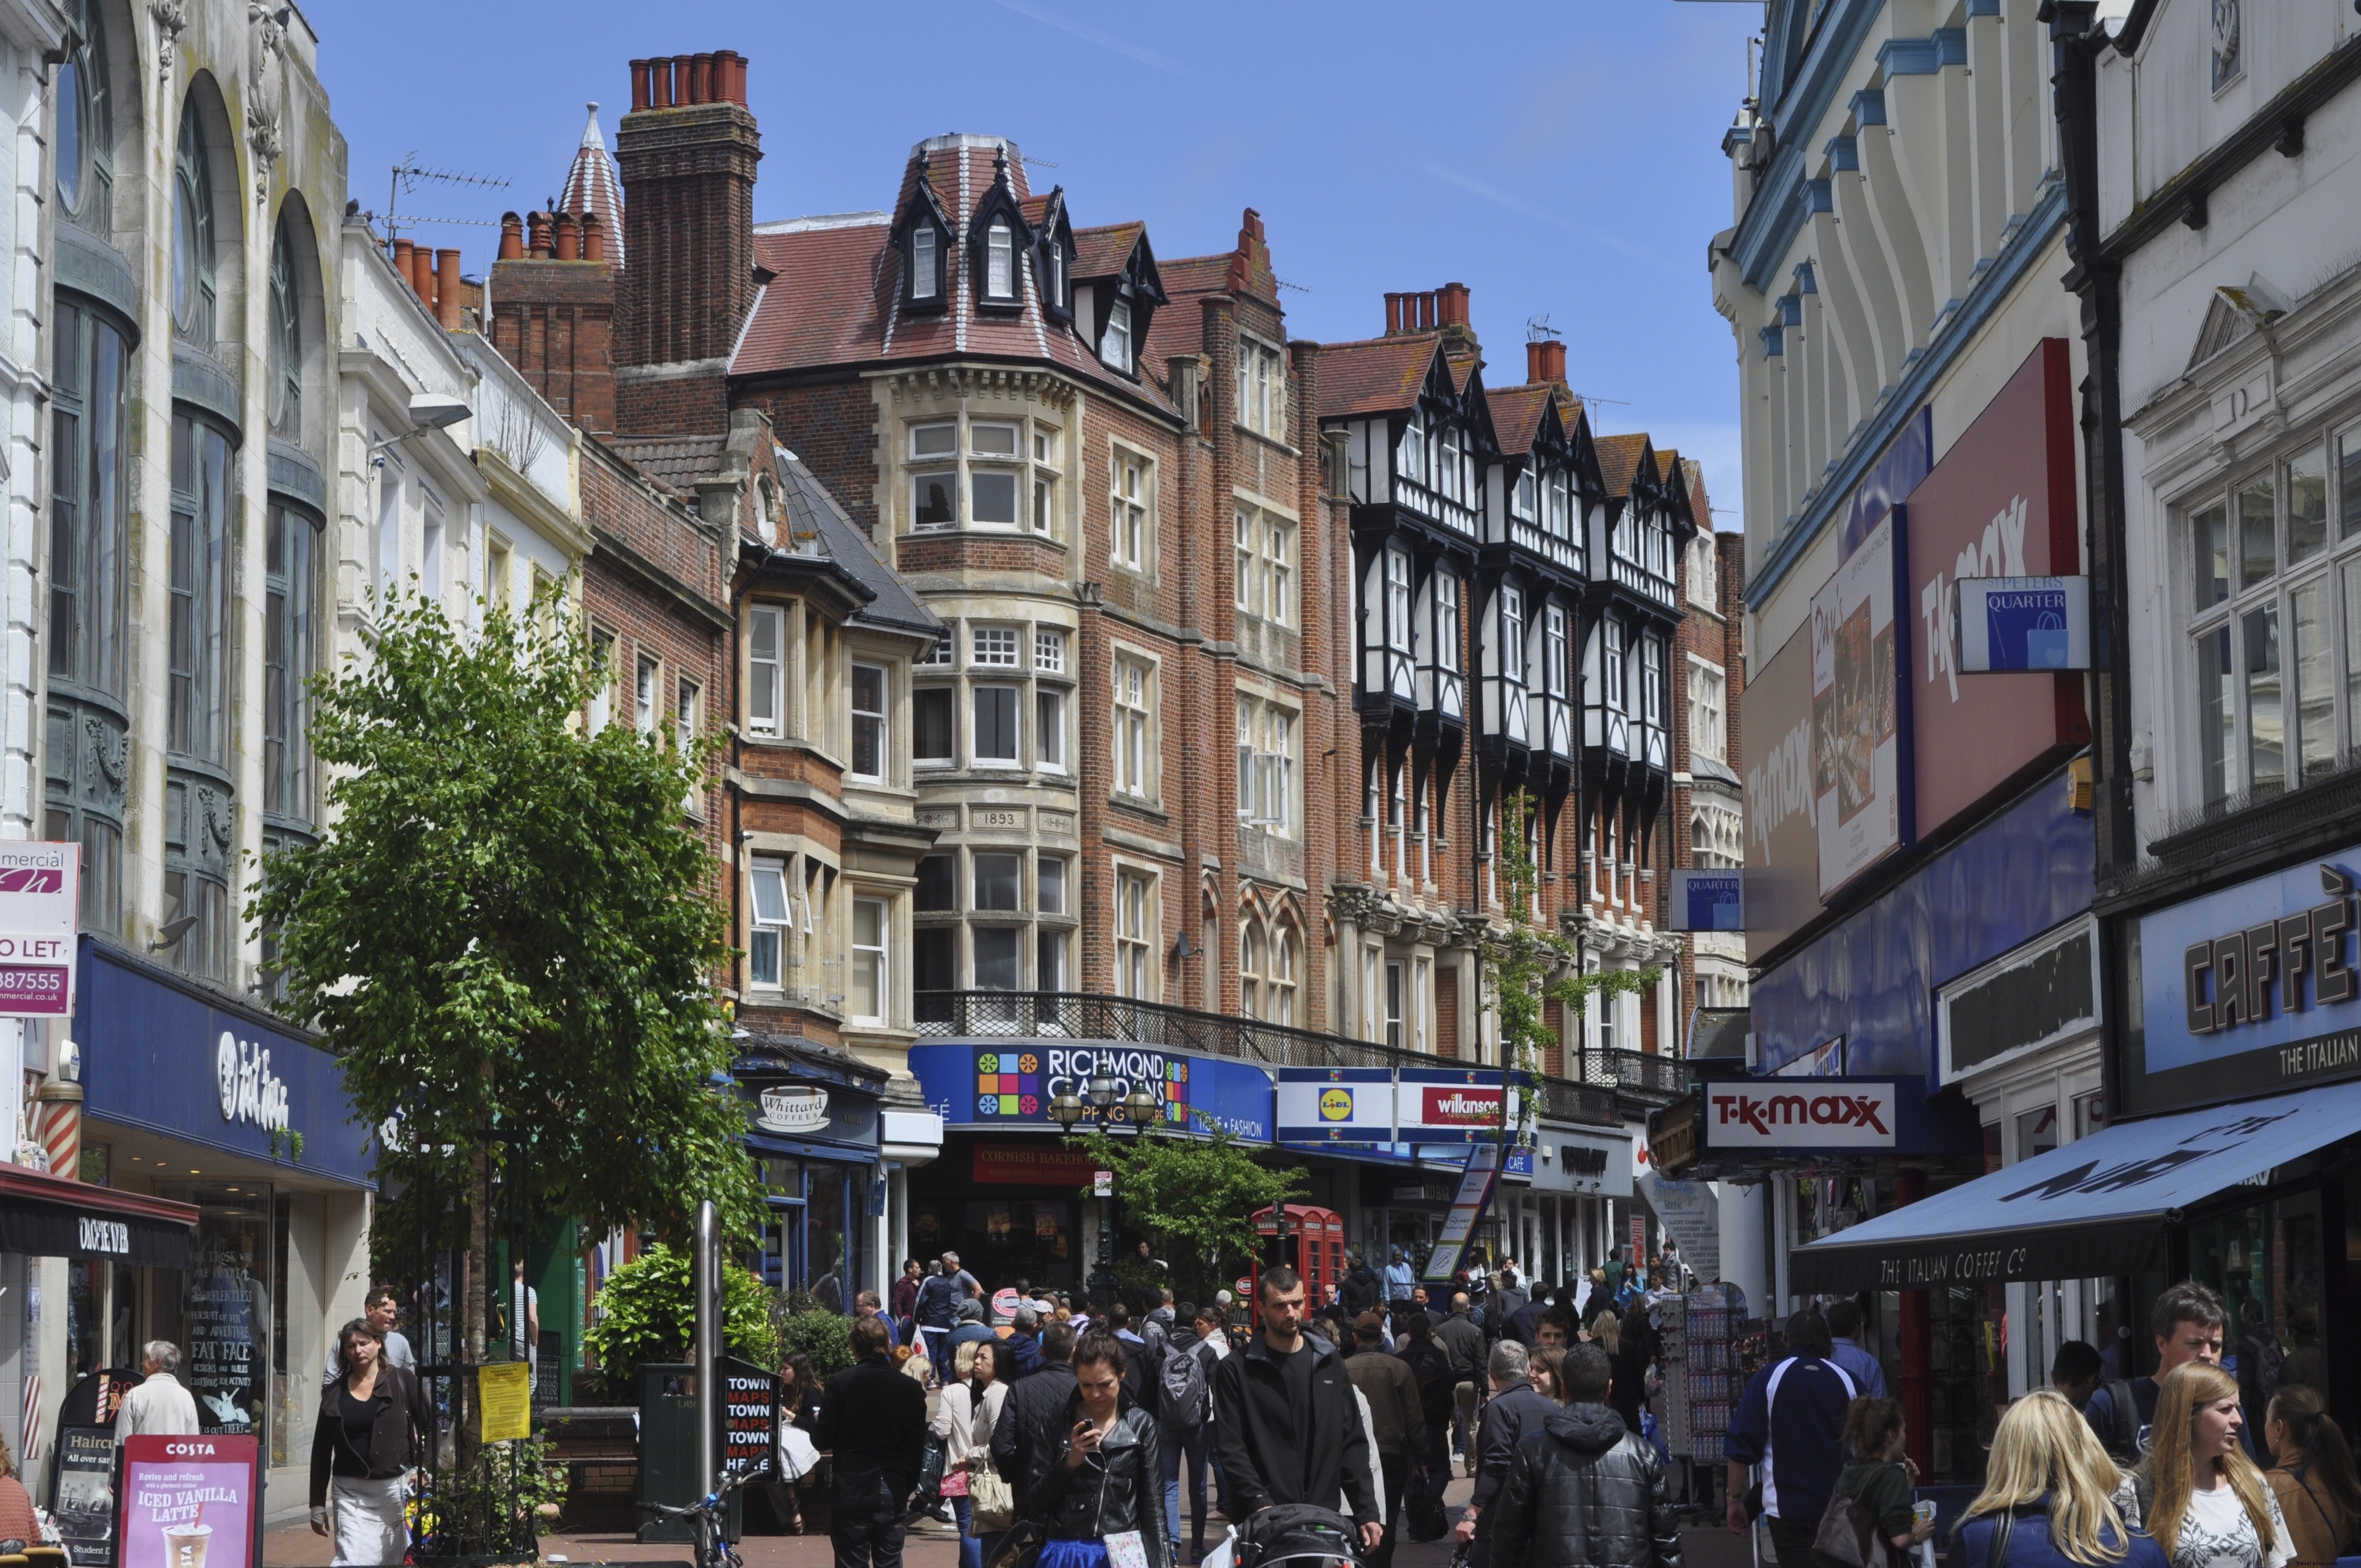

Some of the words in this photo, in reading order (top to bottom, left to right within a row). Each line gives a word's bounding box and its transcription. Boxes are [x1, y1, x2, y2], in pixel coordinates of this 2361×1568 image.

[2002, 576, 2063, 589] PETERS
[1988, 595, 2065, 612] QUARTER
[984, 814, 1014, 825] 1893
[1688, 881, 1738, 892] QUARTER
[23, 940, 61, 958] LET
[2280, 1047, 2304, 1076] THE
[2307, 1035, 2358, 1071] ITALIAN
[764, 1097, 823, 1112] Whittard
[1437, 1094, 1499, 1114] wilkinson
[769, 1112, 818, 1121] COFFEES
[1230, 1118, 1262, 1137] FASHION
[981, 1150, 1035, 1163] CORNISH
[1509, 1157, 1523, 1170] CAFE
[1044, 1170, 1074, 1178] CORNISH
[194, 1268, 208, 1277] ARE
[1881, 1260, 1899, 1283] THE
[1909, 1255, 1947, 1282] ITALIAN
[1955, 1251, 2001, 1278] COFFEE
[206, 1290, 252, 1302] RELENTLESS
[191, 1311, 219, 1320] PURSUIT
[229, 1314, 240, 1323] FUN
[193, 1326, 205, 1335] AND
[210, 1326, 249, 1338] ADVENTURE
[190, 1342, 217, 1359] FAT
[222, 1342, 251, 1361] FACE
[193, 1364, 216, 1373] DESIGNS
[231, 1364, 248, 1373] BUILDS
[190, 1378, 218, 1387] CLOTHING
[728, 1378, 770, 1390] TOWN
[727, 1392, 769, 1403] MAPS
[728, 1405, 769, 1417] TOWN
[70, 1435, 114, 1450] Haircu
[727, 1431, 769, 1443] TOWN
[166, 1443, 215, 1456] COSTA
[138, 1491, 171, 1507] ICED
[176, 1488, 237, 1506] VANILLA
[152, 1505, 199, 1522] LATTE
[73, 1545, 103, 1554] Student
